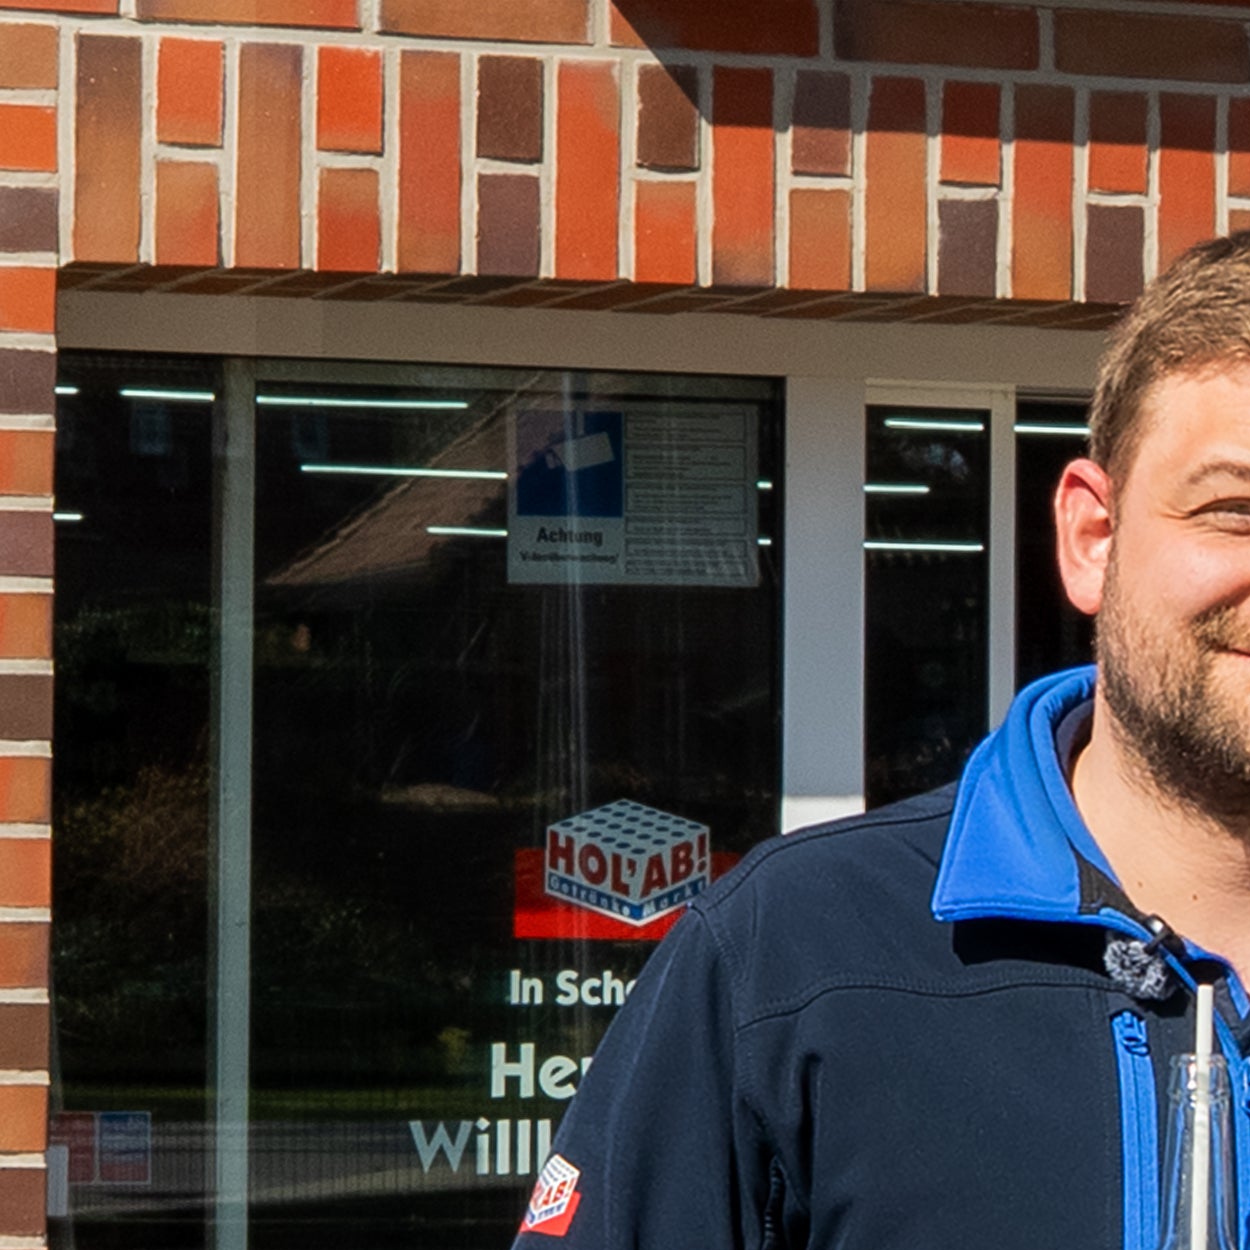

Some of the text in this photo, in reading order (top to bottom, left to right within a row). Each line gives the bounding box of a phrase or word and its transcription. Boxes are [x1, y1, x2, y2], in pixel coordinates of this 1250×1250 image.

[537, 526, 603, 547] Achtung
[510, 970, 543, 1005] In
[491, 1043, 593, 1100] He
